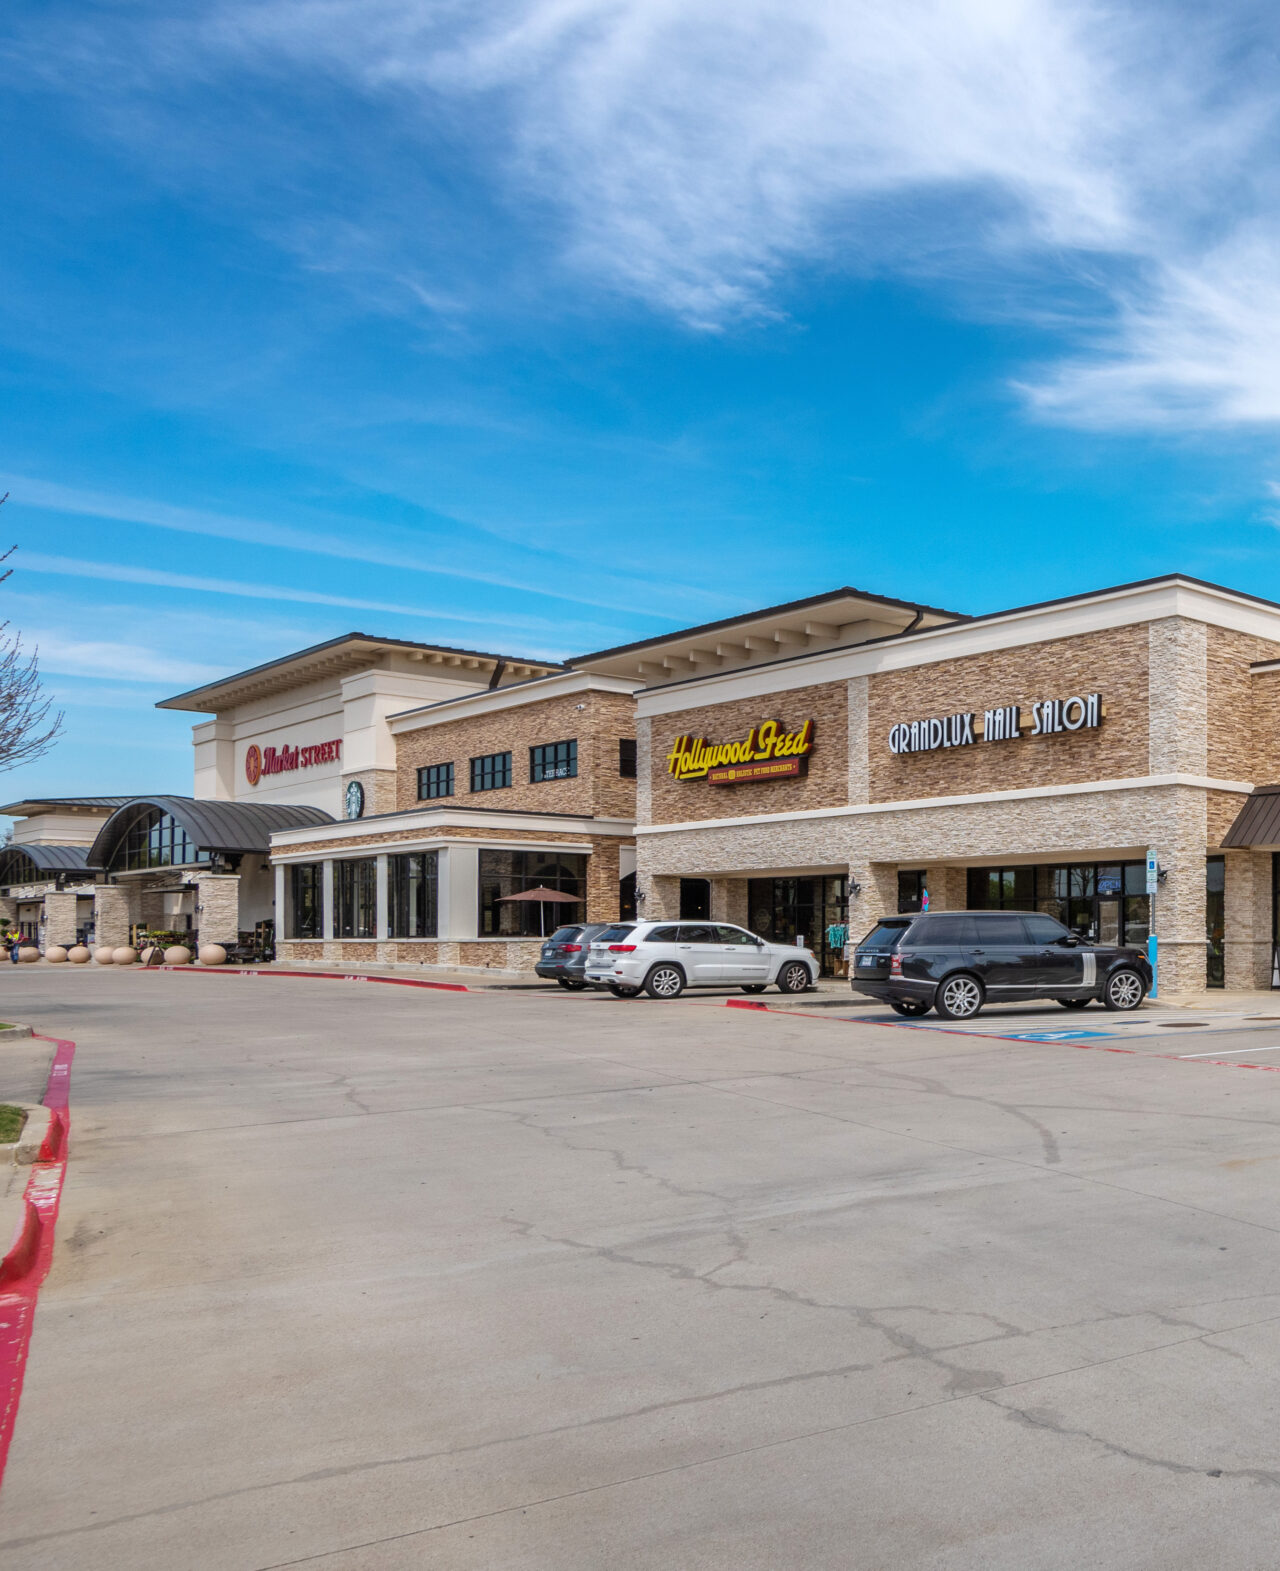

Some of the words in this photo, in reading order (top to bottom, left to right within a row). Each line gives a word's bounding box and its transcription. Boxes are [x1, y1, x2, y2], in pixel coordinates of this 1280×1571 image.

[667, 728, 755, 779] Hollywood
[754, 719, 812, 760] Feed
[889, 713, 976, 754] GRANDLUX
[984, 706, 1021, 742] NAIL
[1032, 694, 1102, 735] SALON
[261, 744, 299, 775] Market
[301, 739, 343, 768] STREET
